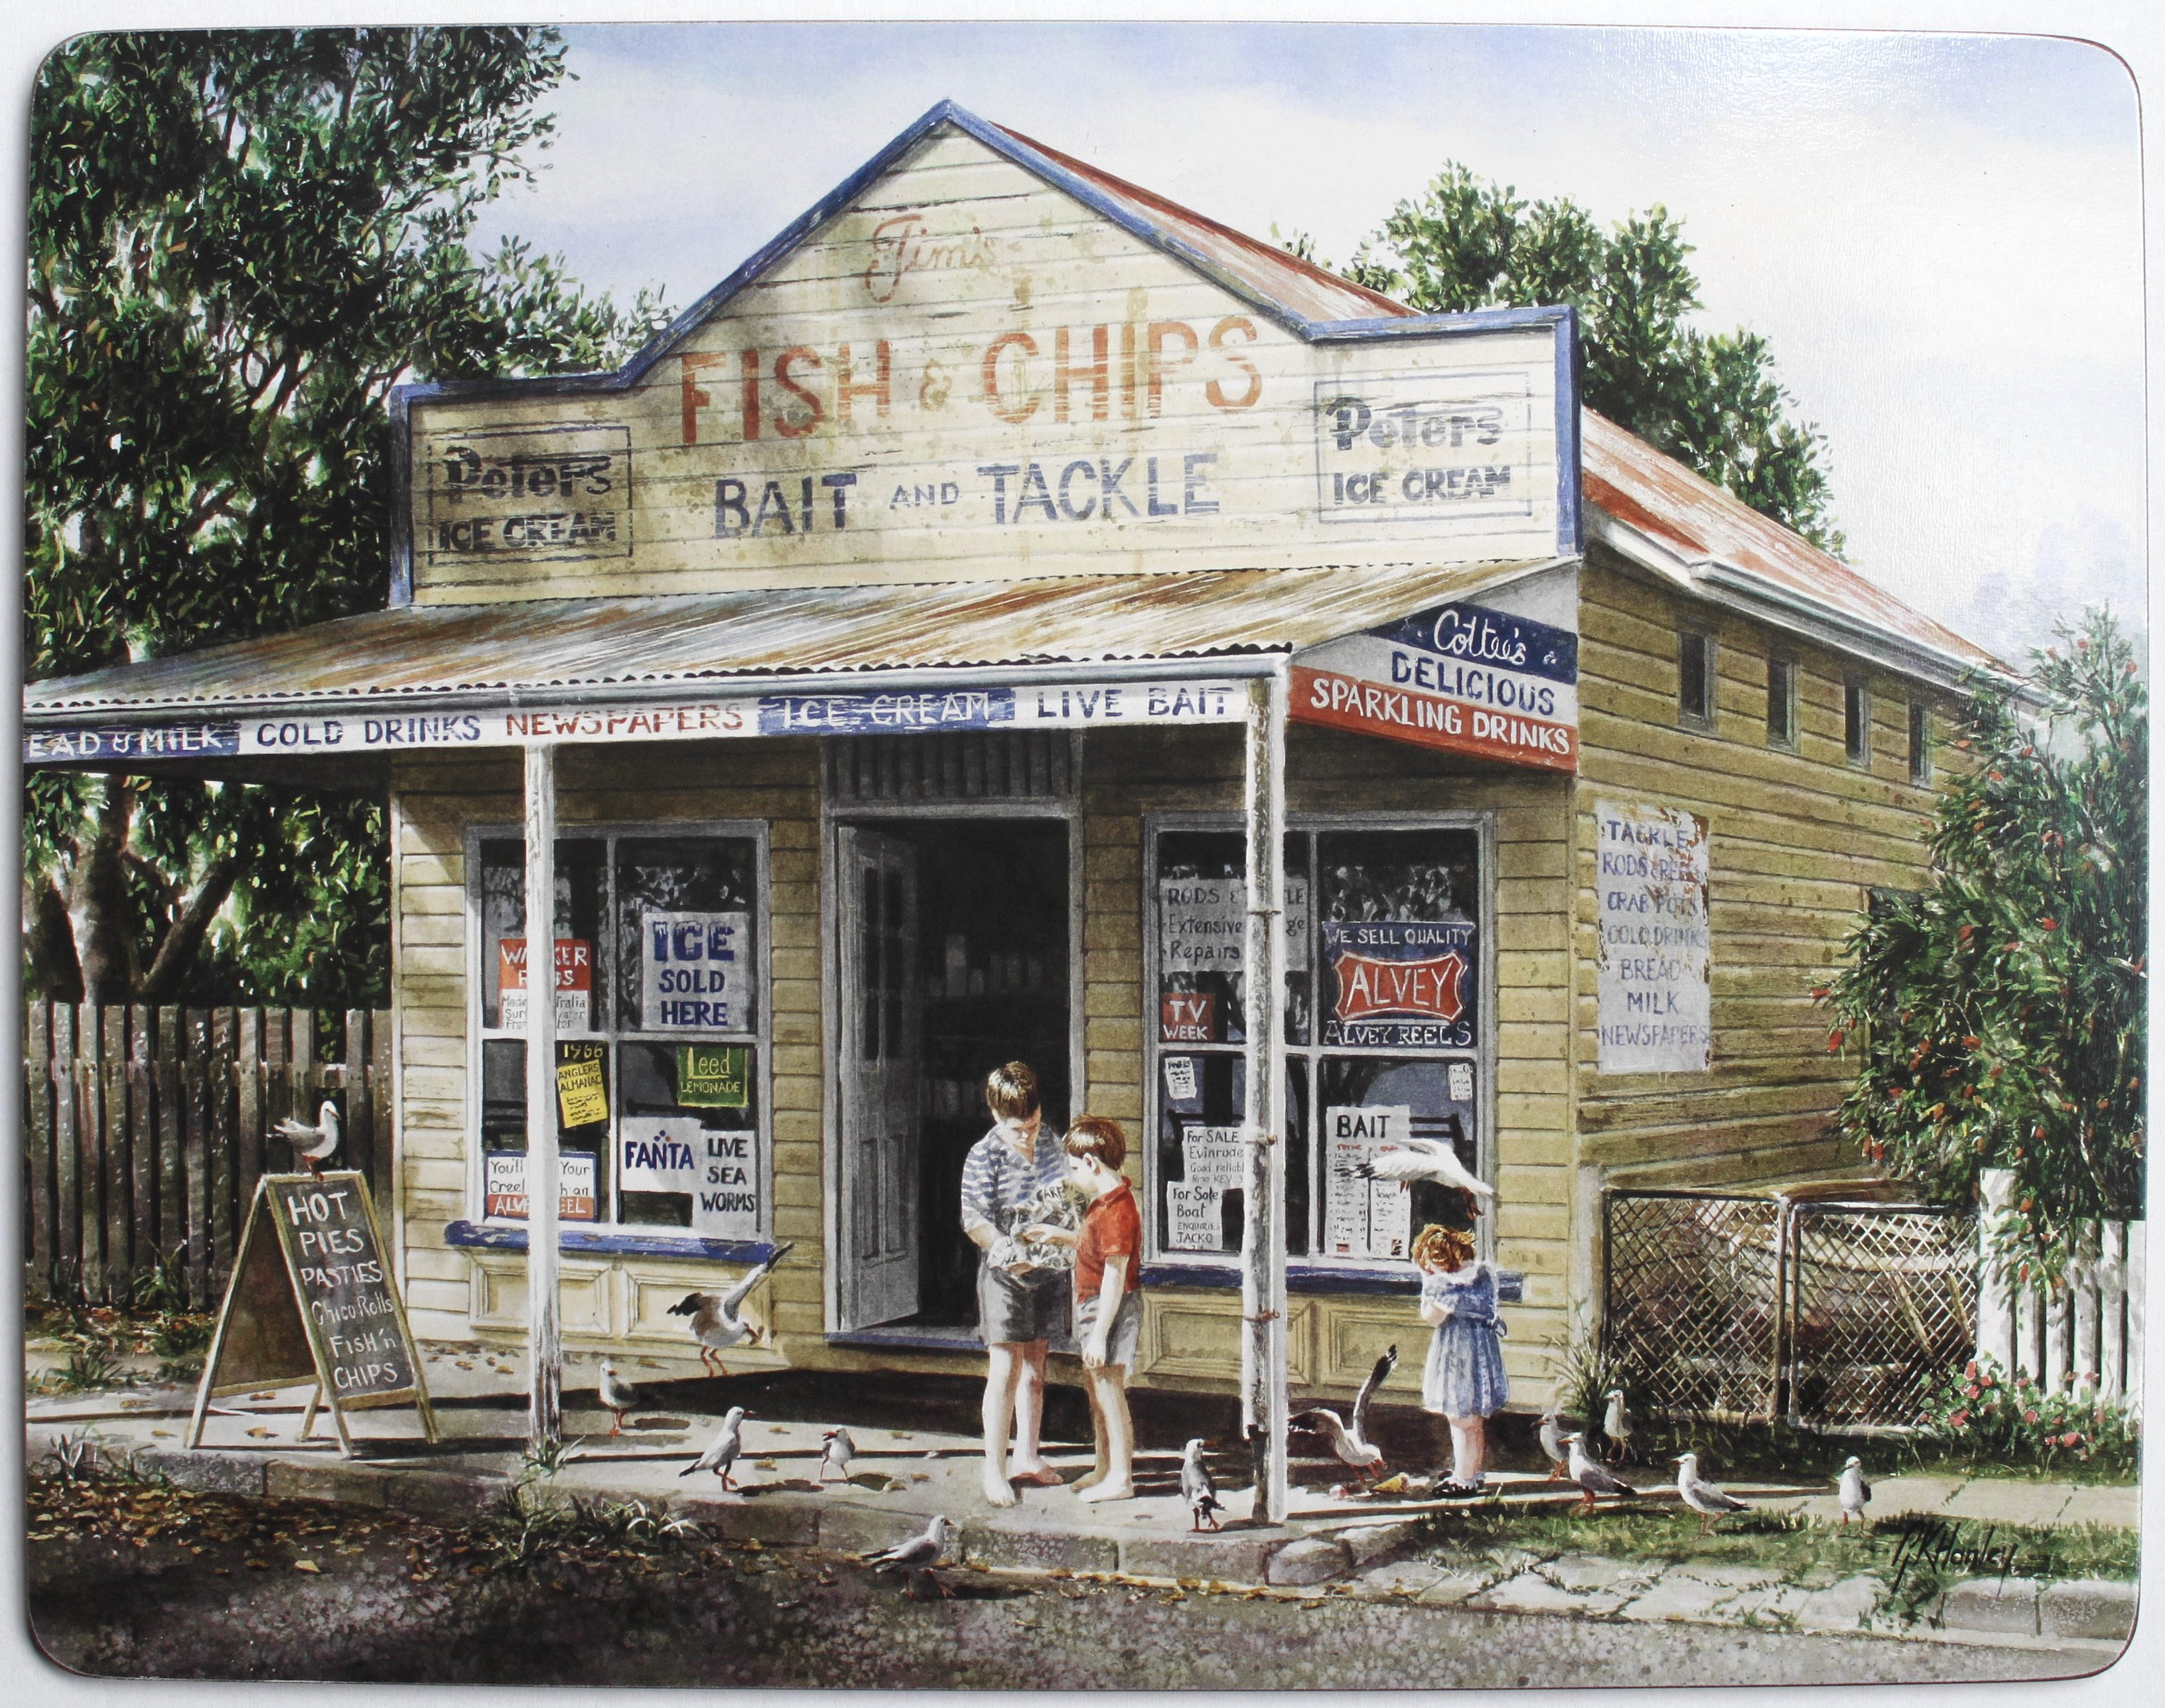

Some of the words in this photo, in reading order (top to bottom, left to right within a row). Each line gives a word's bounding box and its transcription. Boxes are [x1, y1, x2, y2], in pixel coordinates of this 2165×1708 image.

[682, 339, 890, 445] FISH
[920, 360, 951, 411] &
[983, 317, 1263, 424] CHIPS
[715, 474, 857, 539] BAIT
[890, 482, 959, 510] AND
[977, 453, 1220, 524] TACKLE
[1334, 471, 1389, 504] ICE
[1402, 466, 1511, 501] CREAM
[439, 519, 496, 551] ICE
[503, 512, 616, 548] CREAM
[1391, 651, 1555, 715] DELICIOUS
[782, 699, 844, 729] ICE
[870, 692, 990, 725] CREAM
[1037, 689, 1123, 719] LIVE
[1149, 687, 1235, 716] BAIT
[506, 704, 744, 736] NEWSPAPERS
[1310, 677, 1462, 735] SPARKLING
[1472, 711, 1570, 754] DRINKS
[141, 725, 222, 753] MILK
[257, 721, 344, 747] COLD
[365, 715, 481, 744] DRINKS
[1606, 820, 1688, 849] TACKLE
[1603, 852, 1647, 877] RODS
[1168, 887, 1220, 905] RODS
[1608, 891, 1649, 913] CRAB
[1168, 914, 1243, 934] Extensive
[1608, 925, 1649, 946] COLD
[653, 920, 734, 961] ICE
[1326, 928, 1351, 944] WE
[1358, 928, 1400, 945] SELL
[1405, 928, 1472, 945] QUALITY
[1170, 940, 1240, 965] Repairs
[658, 969, 725, 993] SOLD
[1620, 958, 1681, 981] BREAD
[1345, 960, 1453, 1014] ALVEY
[661, 1001, 728, 1026] HERE
[1170, 999, 1207, 1022] TV
[1628, 991, 1679, 1015] MILK
[1163, 1025, 1208, 1040] WEEK
[1324, 1020, 1391, 1045] ALVEY
[1397, 1021, 1472, 1046] REELS
[1601, 1025, 1709, 1047] NEWSPAPERS
[558, 1063, 599, 1080] ANGLERS
[560, 1075, 602, 1093] ALMANAC
[680, 1081, 741, 1094] LEMONADE
[1188, 1130, 1204, 1143] For
[1206, 1129, 1239, 1143] SALE
[1336, 1115, 1391, 1138] BAIT
[625, 1140, 695, 1169] FANTA
[708, 1137, 748, 1157] LIVE
[1190, 1146, 1243, 1159] Evinrude
[561, 1161, 590, 1175] Your
[707, 1167, 746, 1185] SEA
[1216, 1162, 1244, 1173] reliabl
[490, 1178, 525, 1193] Creel
[1172, 1188, 1192, 1200] For
[287, 1190, 348, 1226] HOT
[494, 1196, 529, 1215] ALV
[559, 1198, 586, 1214] EEL
[700, 1193, 755, 1212] WORMS
[1176, 1202, 1206, 1218] Boat
[299, 1228, 364, 1257] PIES
[1176, 1232, 1213, 1244] JACKO
[300, 1260, 383, 1287] PASTIES
[312, 1300, 356, 1326] Chico
[358, 1291, 393, 1317] Rolls
[334, 1362, 397, 1389] CHIPS
